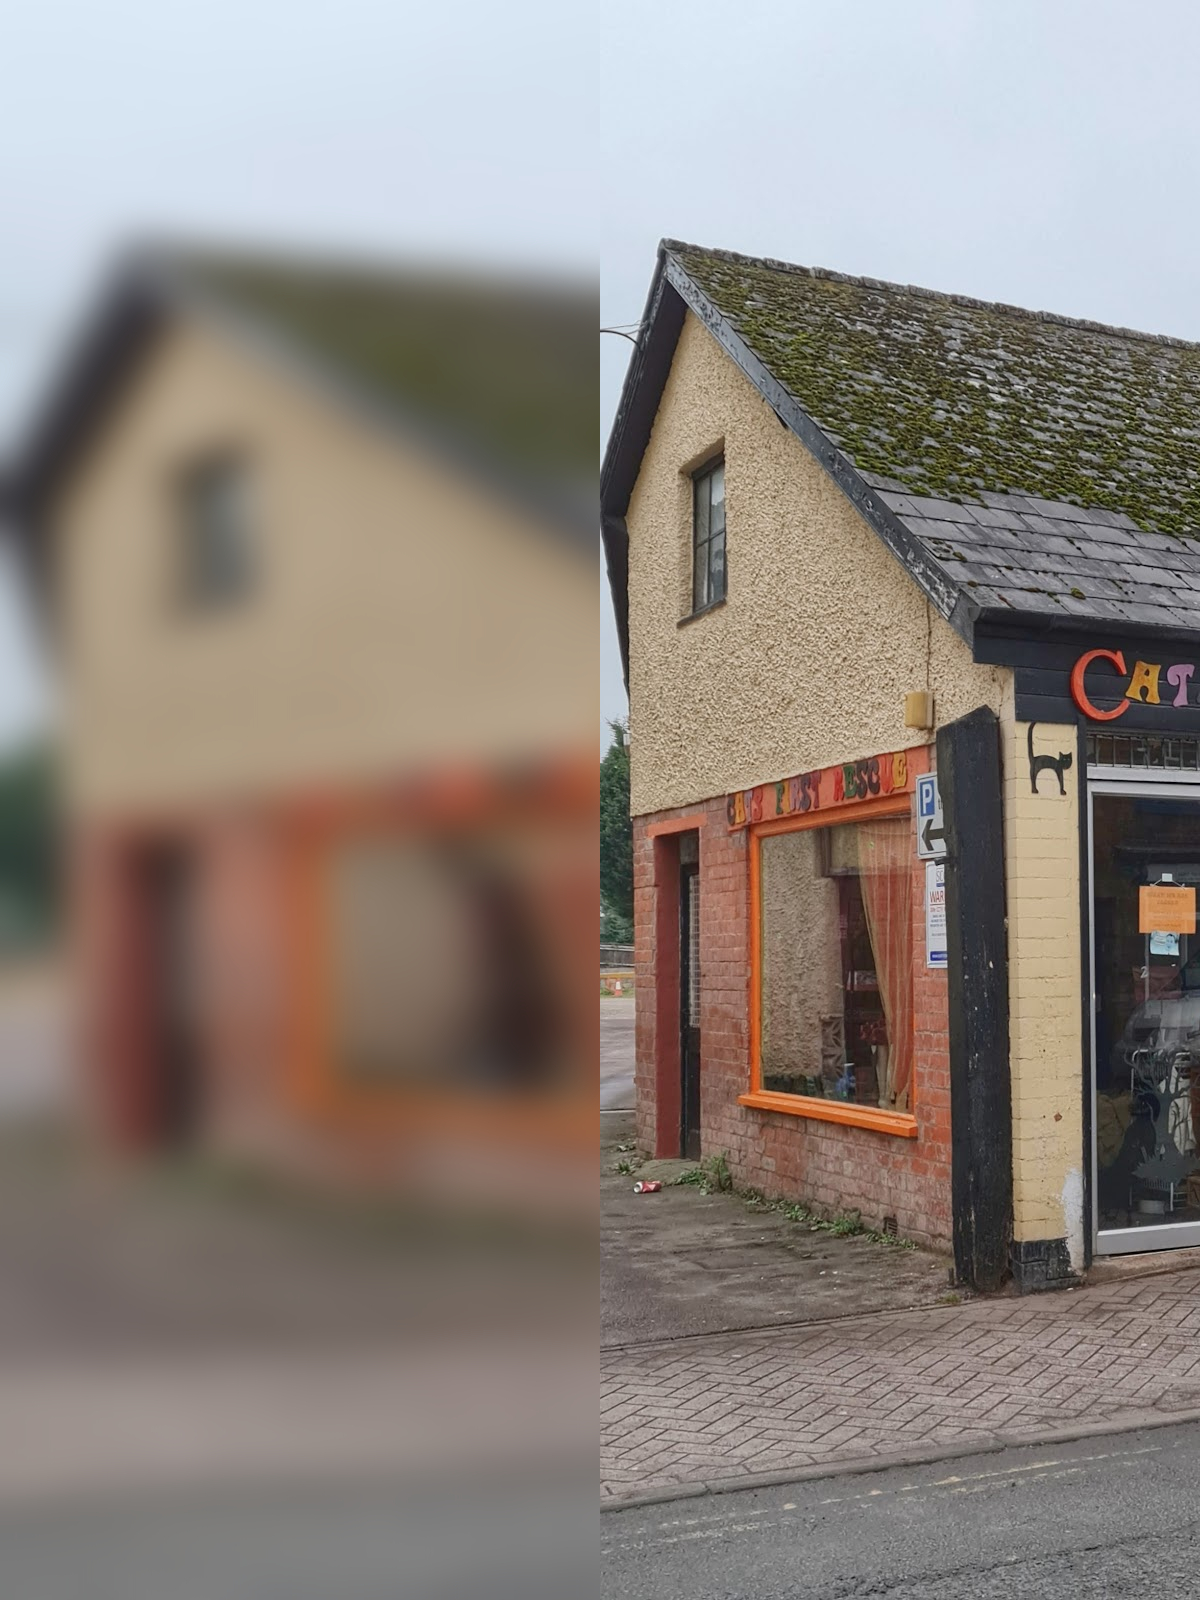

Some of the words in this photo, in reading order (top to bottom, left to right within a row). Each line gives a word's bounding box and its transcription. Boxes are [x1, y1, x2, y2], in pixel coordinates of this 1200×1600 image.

[727, 788, 763, 825] CATS
[776, 770, 821, 815] FIRST
[833, 752, 907, 800] RESCUE
[922, 783, 932, 814] P
